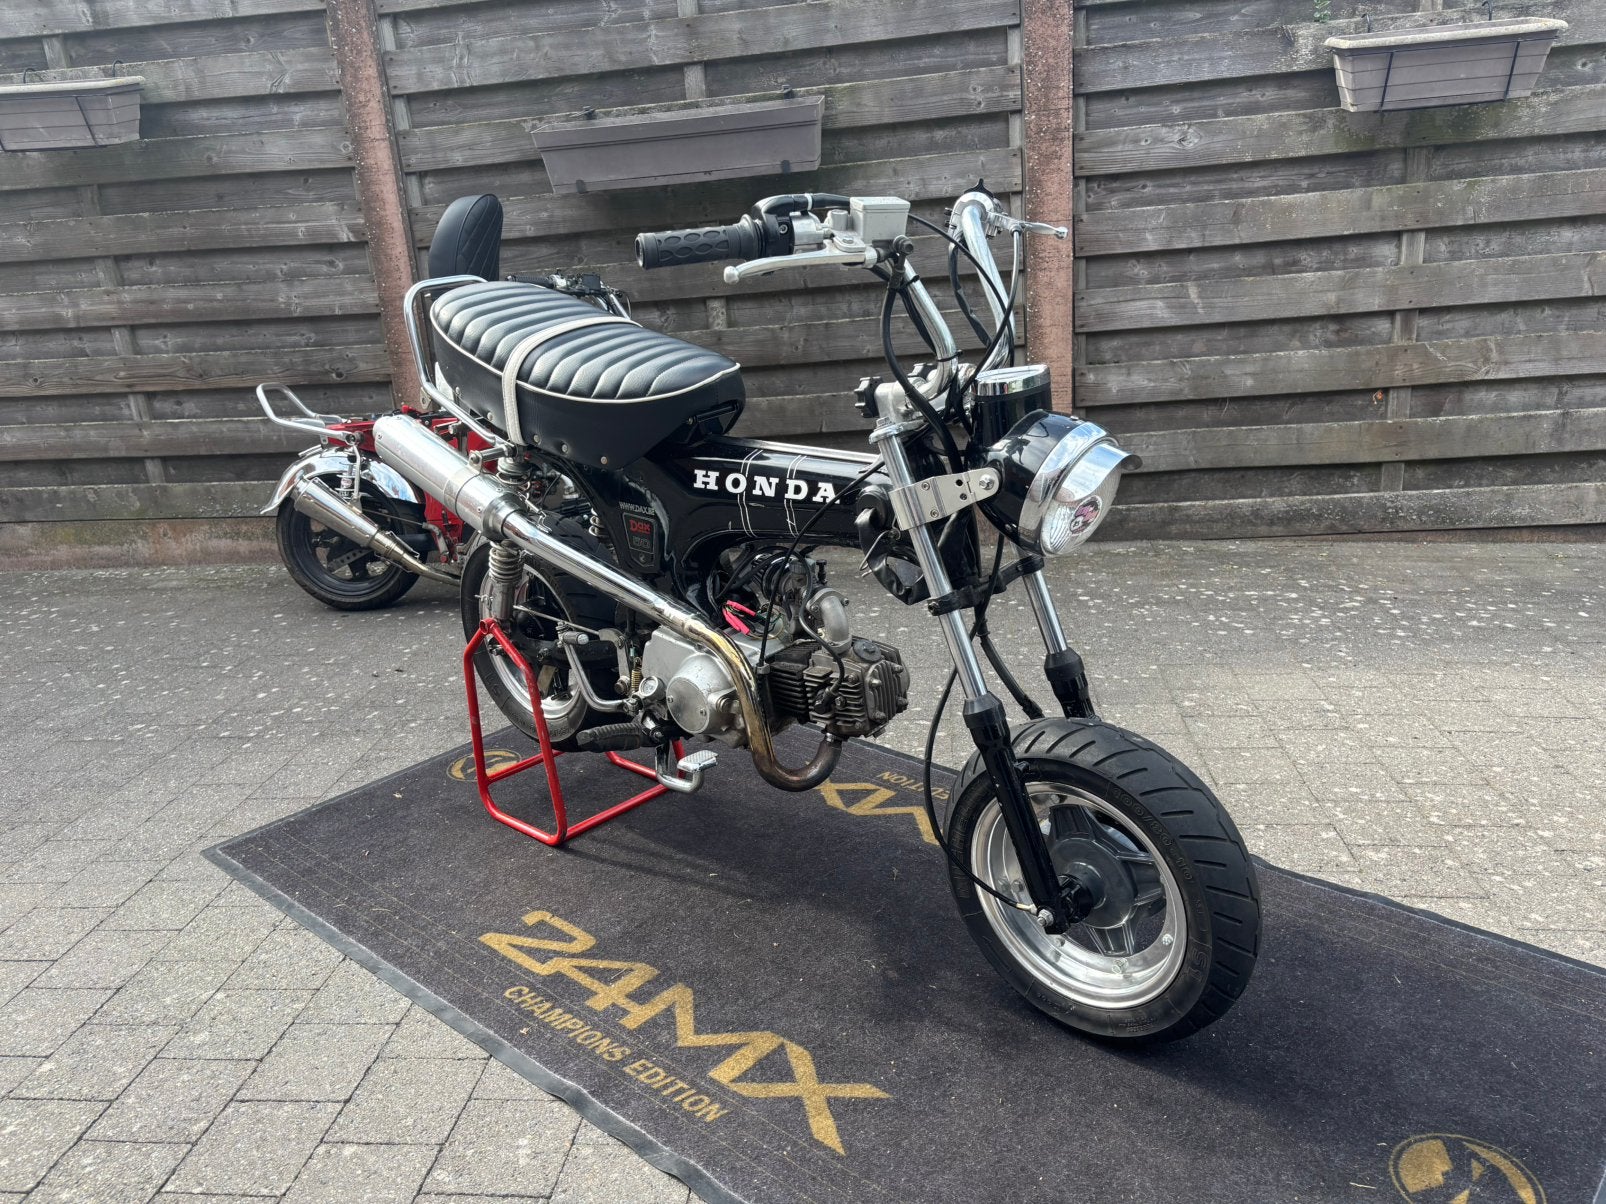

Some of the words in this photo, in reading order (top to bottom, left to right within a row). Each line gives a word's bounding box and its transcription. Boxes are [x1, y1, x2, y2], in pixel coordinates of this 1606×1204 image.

[693, 469, 841, 505] HONDA
[478, 910, 893, 1157] 24MX
[503, 985, 632, 1062] CHAMPIONS
[622, 1058, 731, 1123] EDITION
